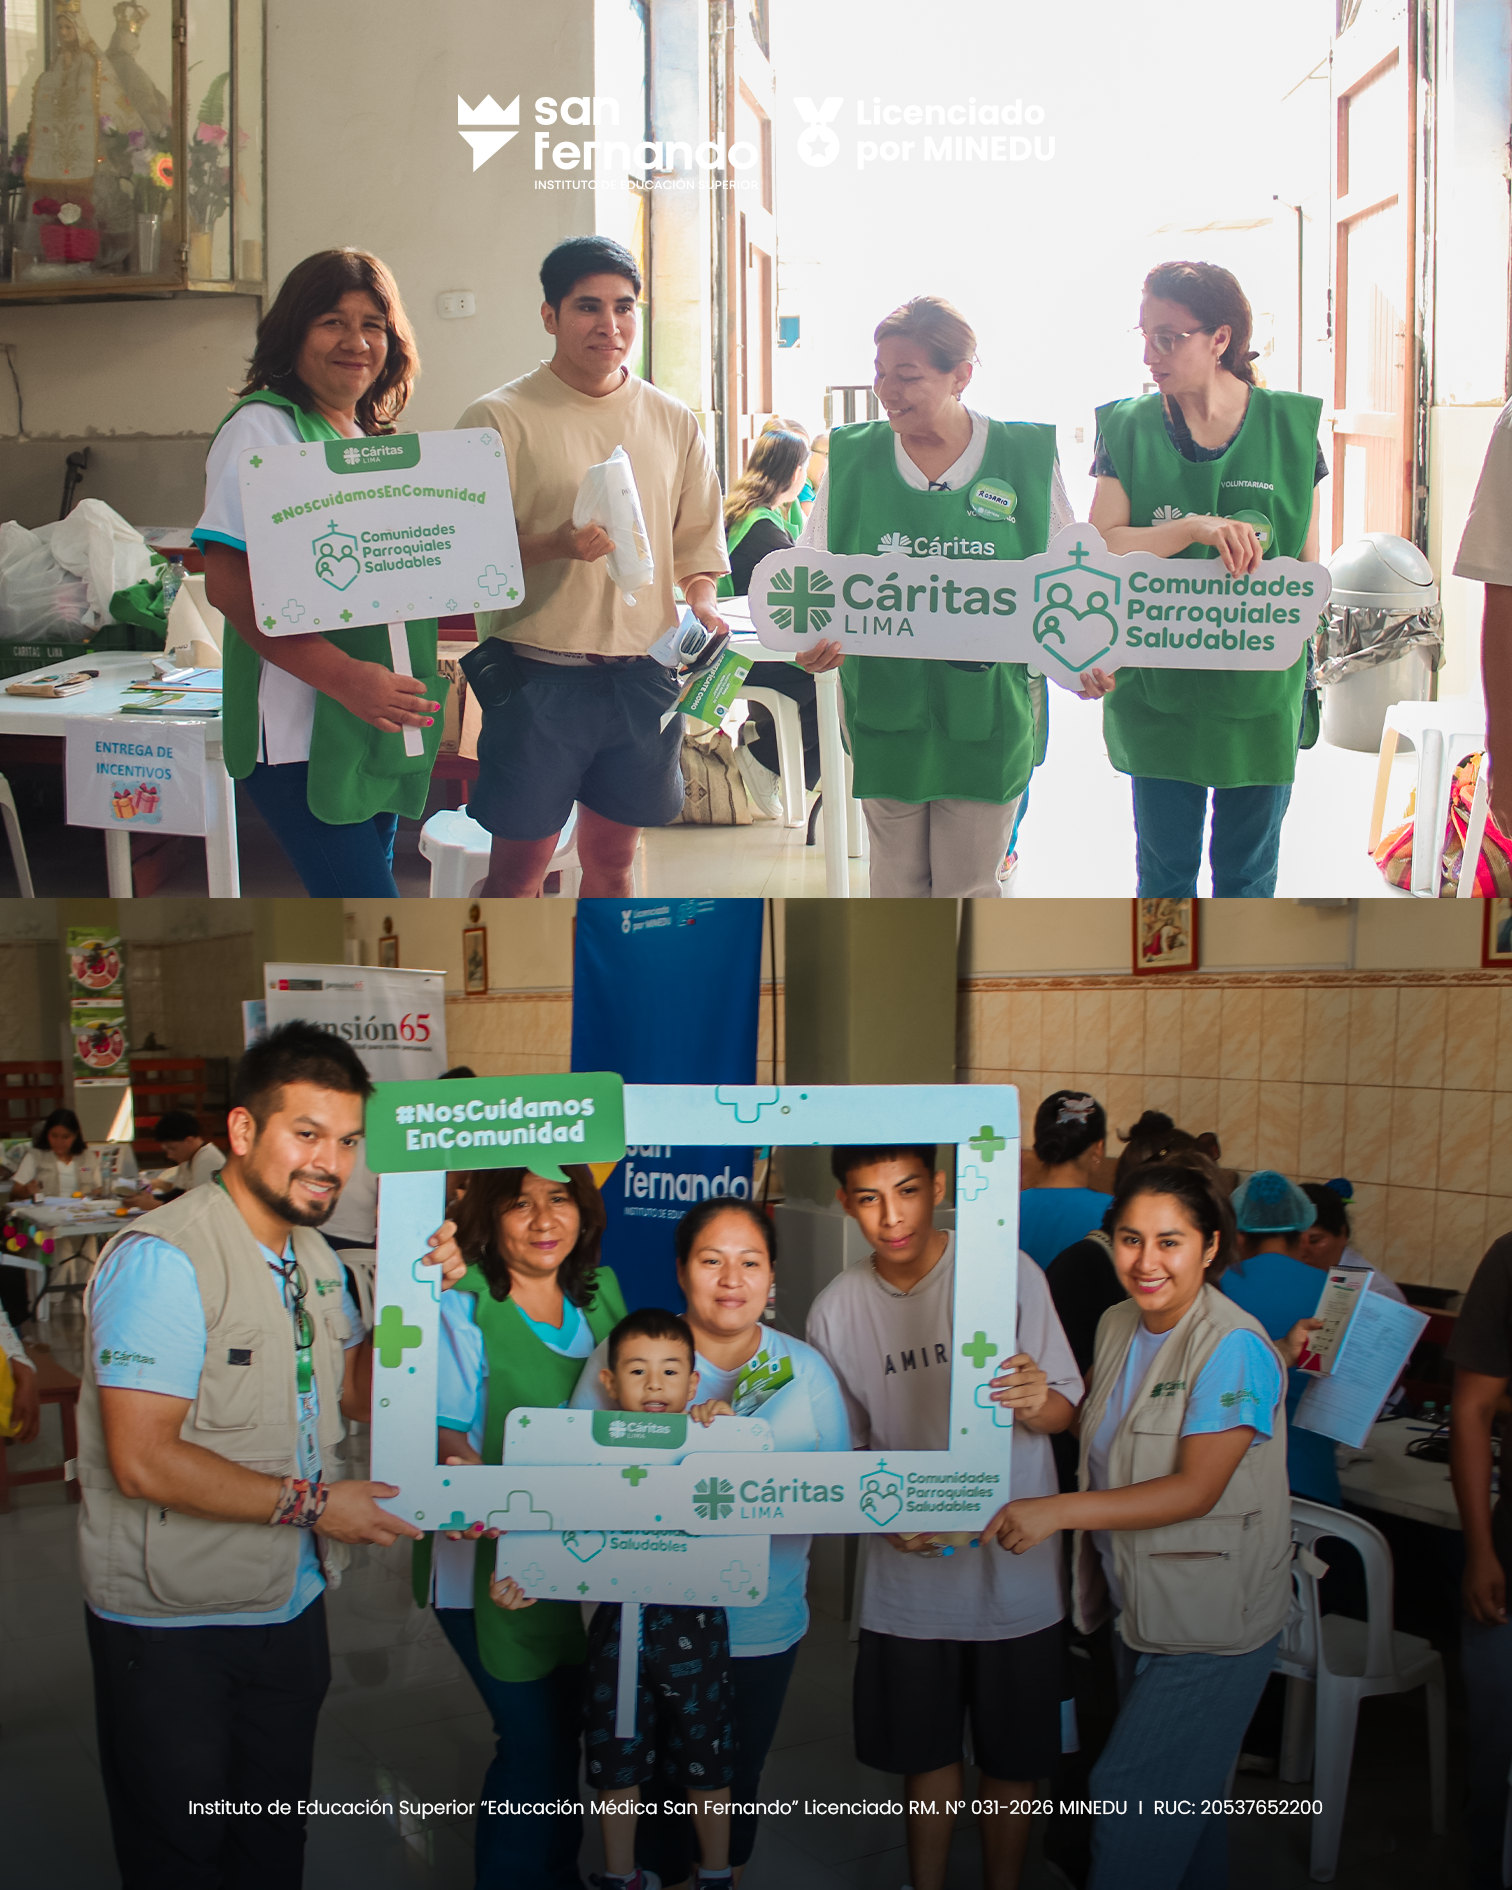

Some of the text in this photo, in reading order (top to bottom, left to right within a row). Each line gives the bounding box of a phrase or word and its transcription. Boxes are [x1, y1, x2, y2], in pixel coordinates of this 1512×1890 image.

[361, 445, 404, 458] Cáritas
[363, 456, 381, 464] LIMA
[1220, 480, 1274, 491] VOLUNTARIADO
[978, 490, 1009, 507] ROSARIO
[361, 524, 456, 544] Comunidades
[362, 539, 452, 559] Parroquiales
[914, 536, 995, 557] Cáritas
[364, 555, 442, 574] Saludables
[842, 571, 1018, 617] Cáritas
[1128, 571, 1315, 598] Comunidades
[1126, 599, 1301, 629] Parroquiales
[844, 614, 914, 637] LIMA
[1125, 625, 1276, 651] Saludables
[95, 741, 173, 759] ENTREGA DE
[96, 762, 172, 780] INCENTIVOS
[320, 1012, 431, 1043] nsión65
[395, 1096, 595, 1125] #NosCuidamos
[405, 1119, 585, 1151] EnComunidad
[624, 1161, 750, 1202] fernando
[626, 1422, 671, 1435] Cáritas
[907, 1472, 1000, 1484] Comunidades
[739, 1477, 845, 1504] Cáritas
[906, 1486, 994, 1499] Parroquiales
[740, 1506, 785, 1519] LIMA
[906, 1500, 982, 1512] Saludables
[609, 1537, 688, 1553] Saludables
